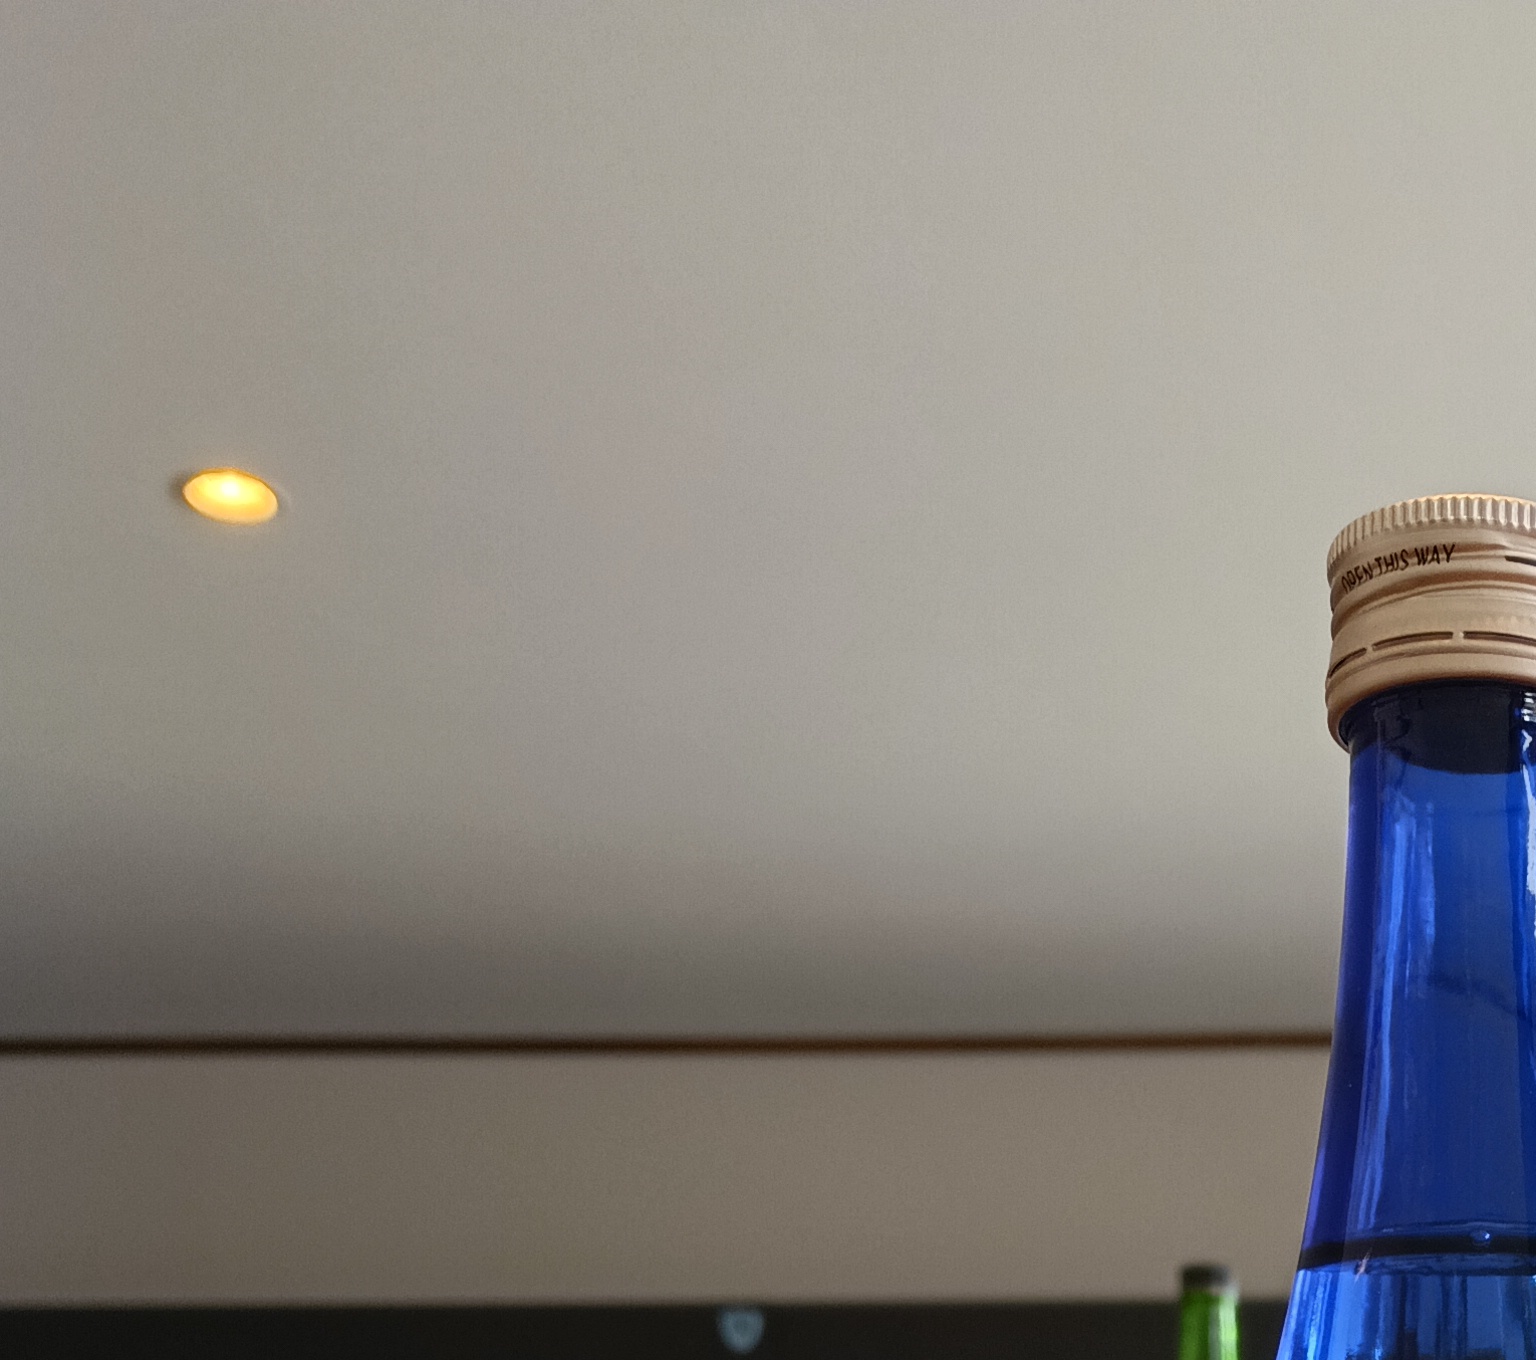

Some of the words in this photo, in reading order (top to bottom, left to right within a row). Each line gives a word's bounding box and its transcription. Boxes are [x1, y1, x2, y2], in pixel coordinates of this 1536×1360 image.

[1341, 561, 1375, 594] OPEN
[1375, 548, 1410, 577] THIS
[1414, 542, 1456, 567] WAY
